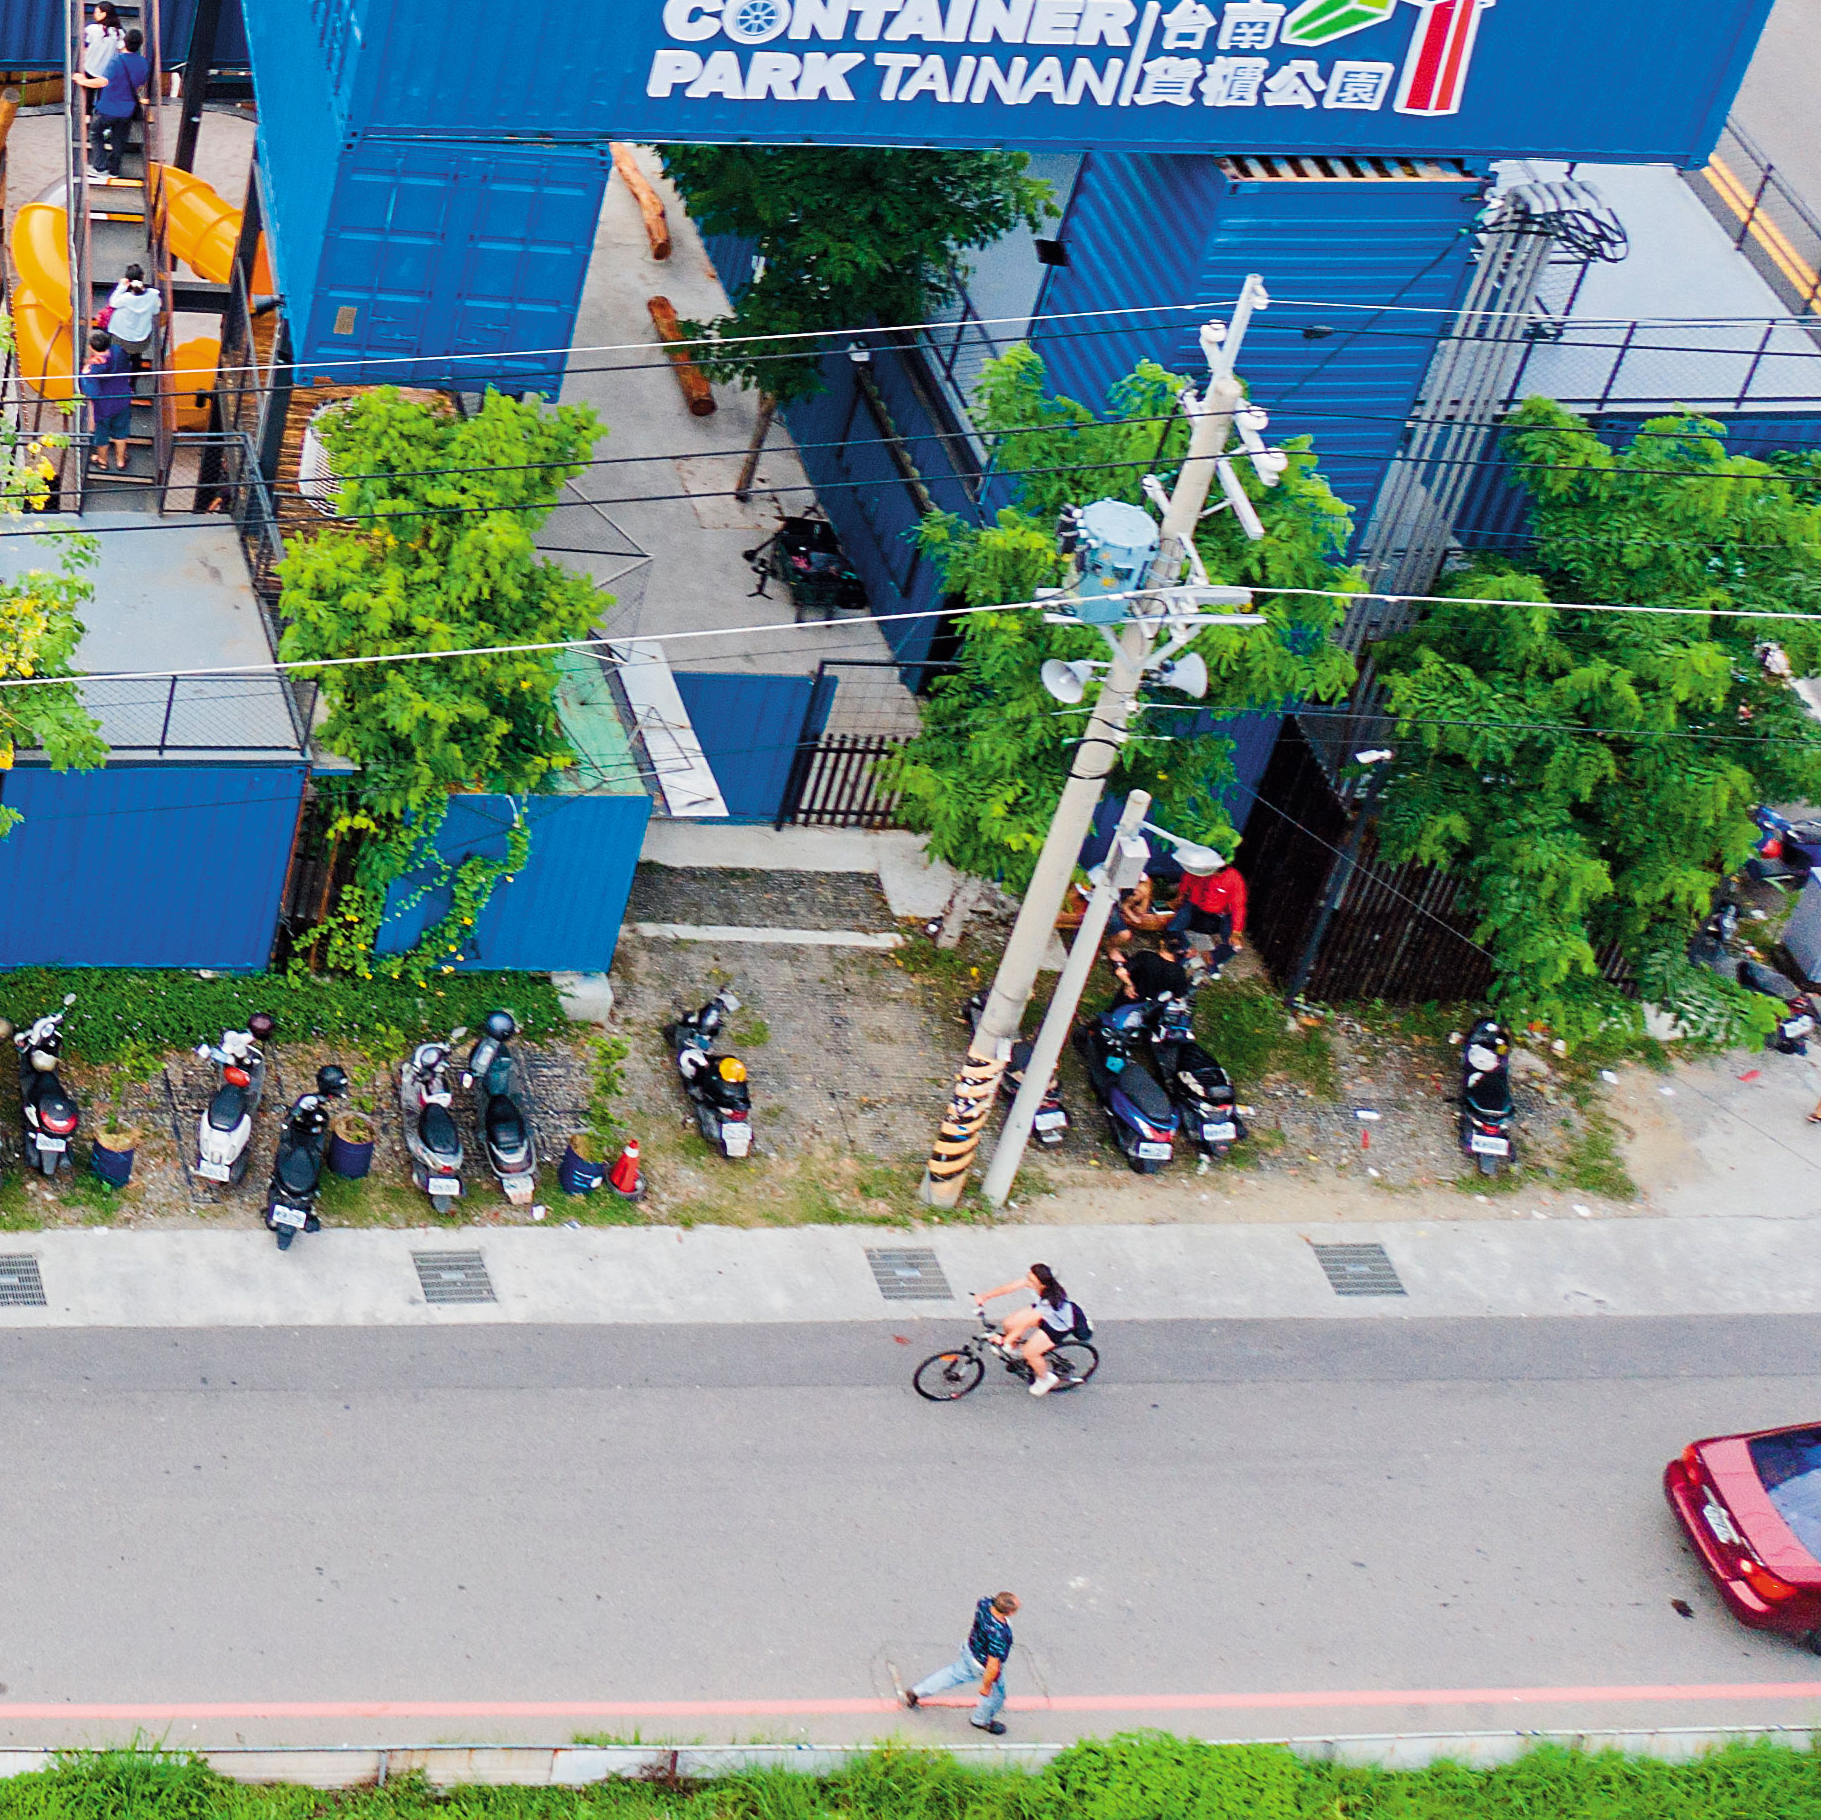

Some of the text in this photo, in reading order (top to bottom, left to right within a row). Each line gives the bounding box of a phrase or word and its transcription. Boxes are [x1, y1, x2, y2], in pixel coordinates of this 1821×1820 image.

[647, 49, 1125, 106] PARK TAINAN
[1135, 55, 1395, 111] 貨櫃公園
